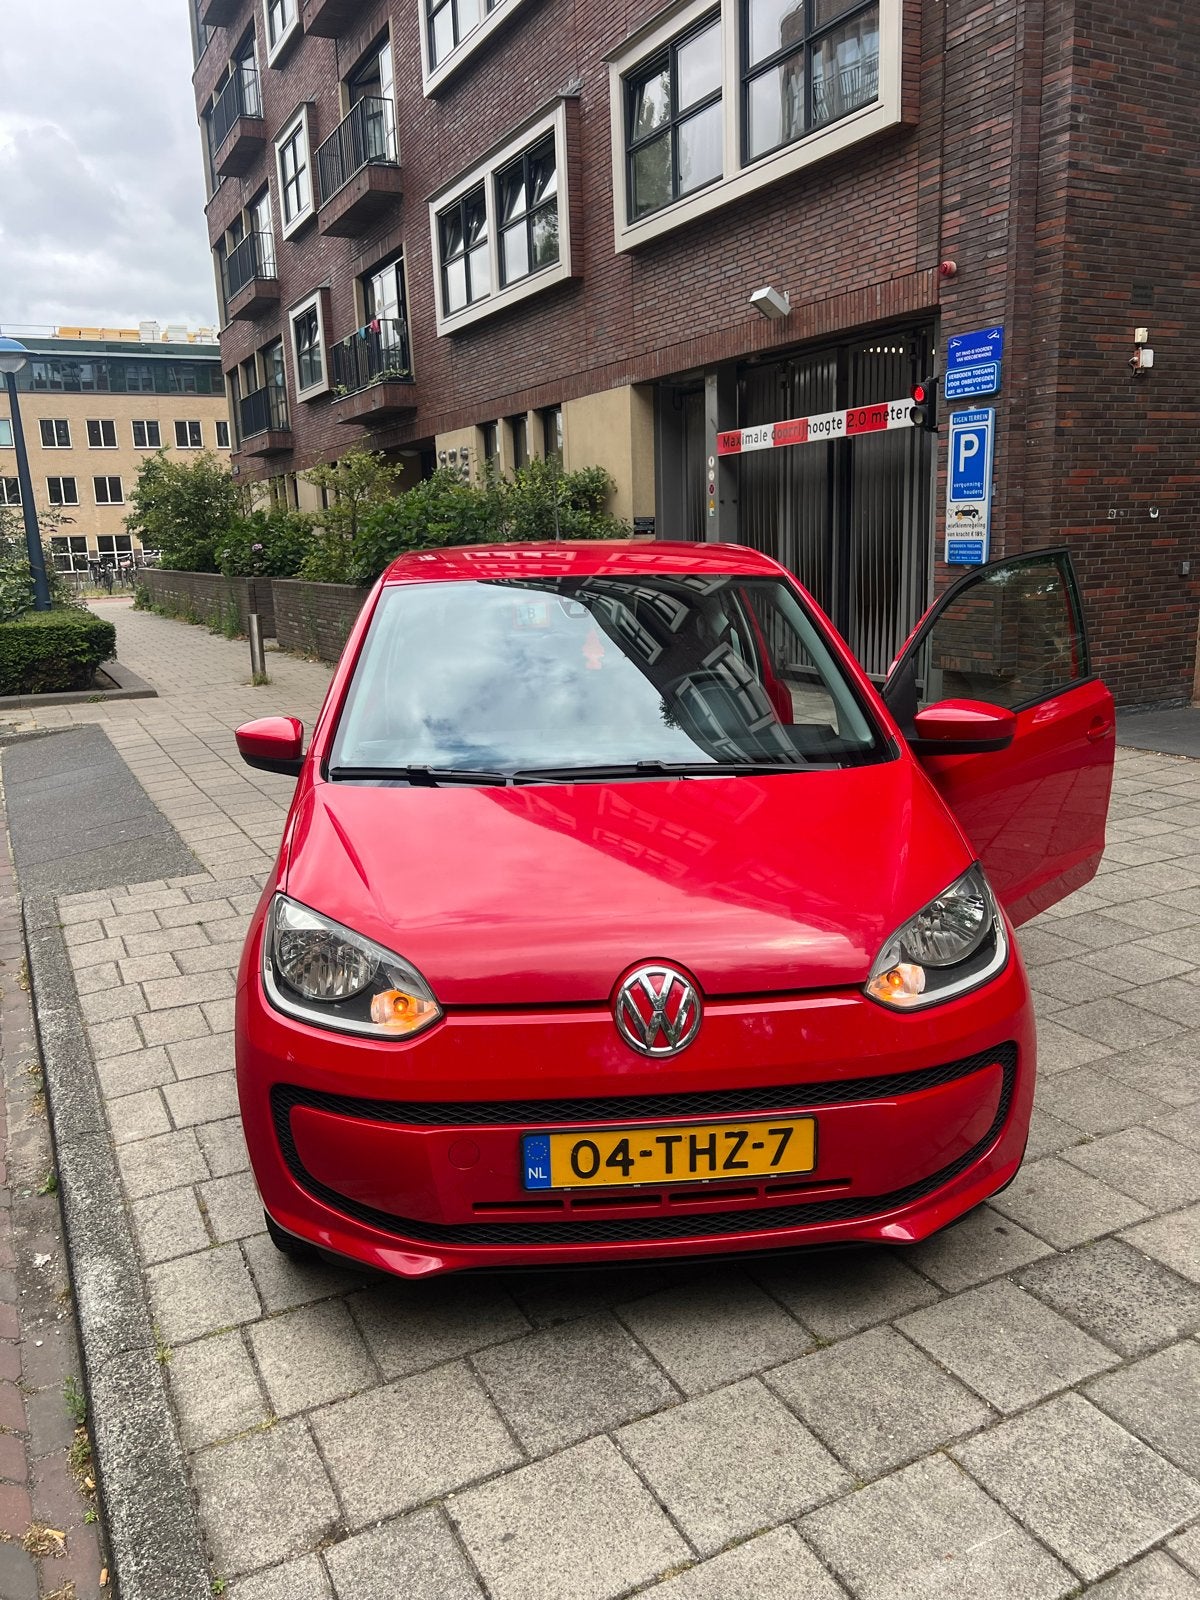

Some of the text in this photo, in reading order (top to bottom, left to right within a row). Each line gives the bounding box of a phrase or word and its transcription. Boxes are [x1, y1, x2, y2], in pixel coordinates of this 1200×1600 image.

[948, 366, 994, 380] VERBODEN TOEGANG
[961, 375, 994, 385] ONBEVOEGDEN
[722, 431, 768, 449] Maximale
[771, 416, 843, 441] doorrijhoogte
[871, 404, 910, 423] meter
[953, 413, 988, 424] EIGEN TERREIN
[958, 433, 979, 472] P
[618, 965, 699, 1054] VW
[528, 1127, 794, 1180] NL 04-THZ-7
